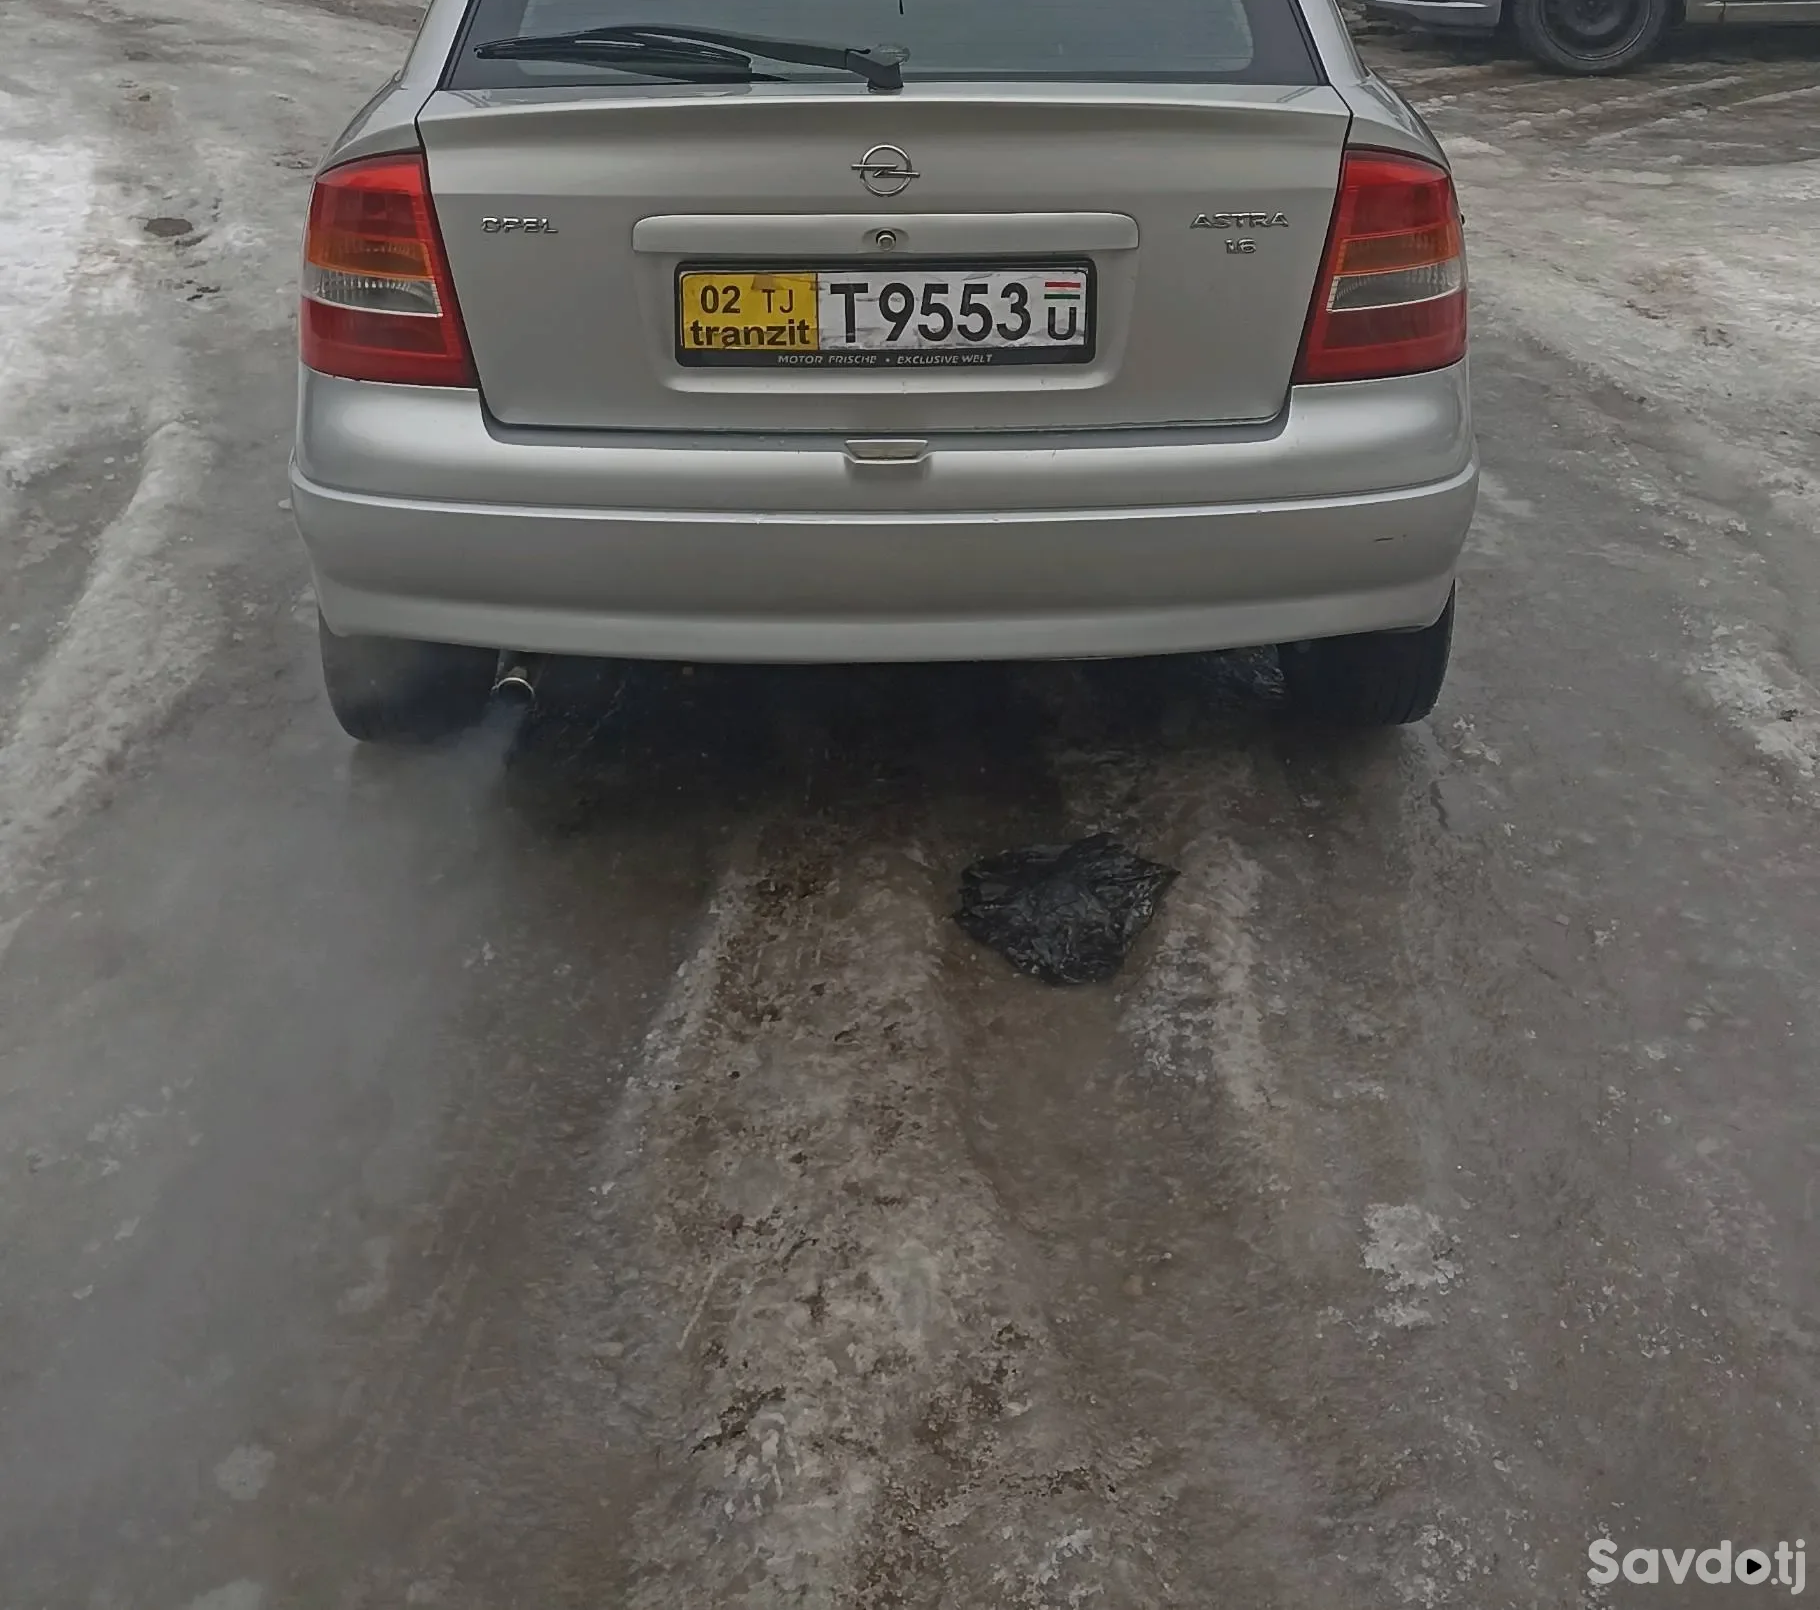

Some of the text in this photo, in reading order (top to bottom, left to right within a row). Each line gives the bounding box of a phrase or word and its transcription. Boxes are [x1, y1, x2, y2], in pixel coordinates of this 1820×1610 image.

[481, 217, 559, 233] OPEL
[1190, 212, 1289, 228] ASTRA
[700, 285, 794, 314] 02 TJ
[690, 319, 811, 346] tranzit
[1047, 306, 1077, 341] U
[777, 354, 993, 364] MOTOR FRISCHE EXCLUSIVE WELT
